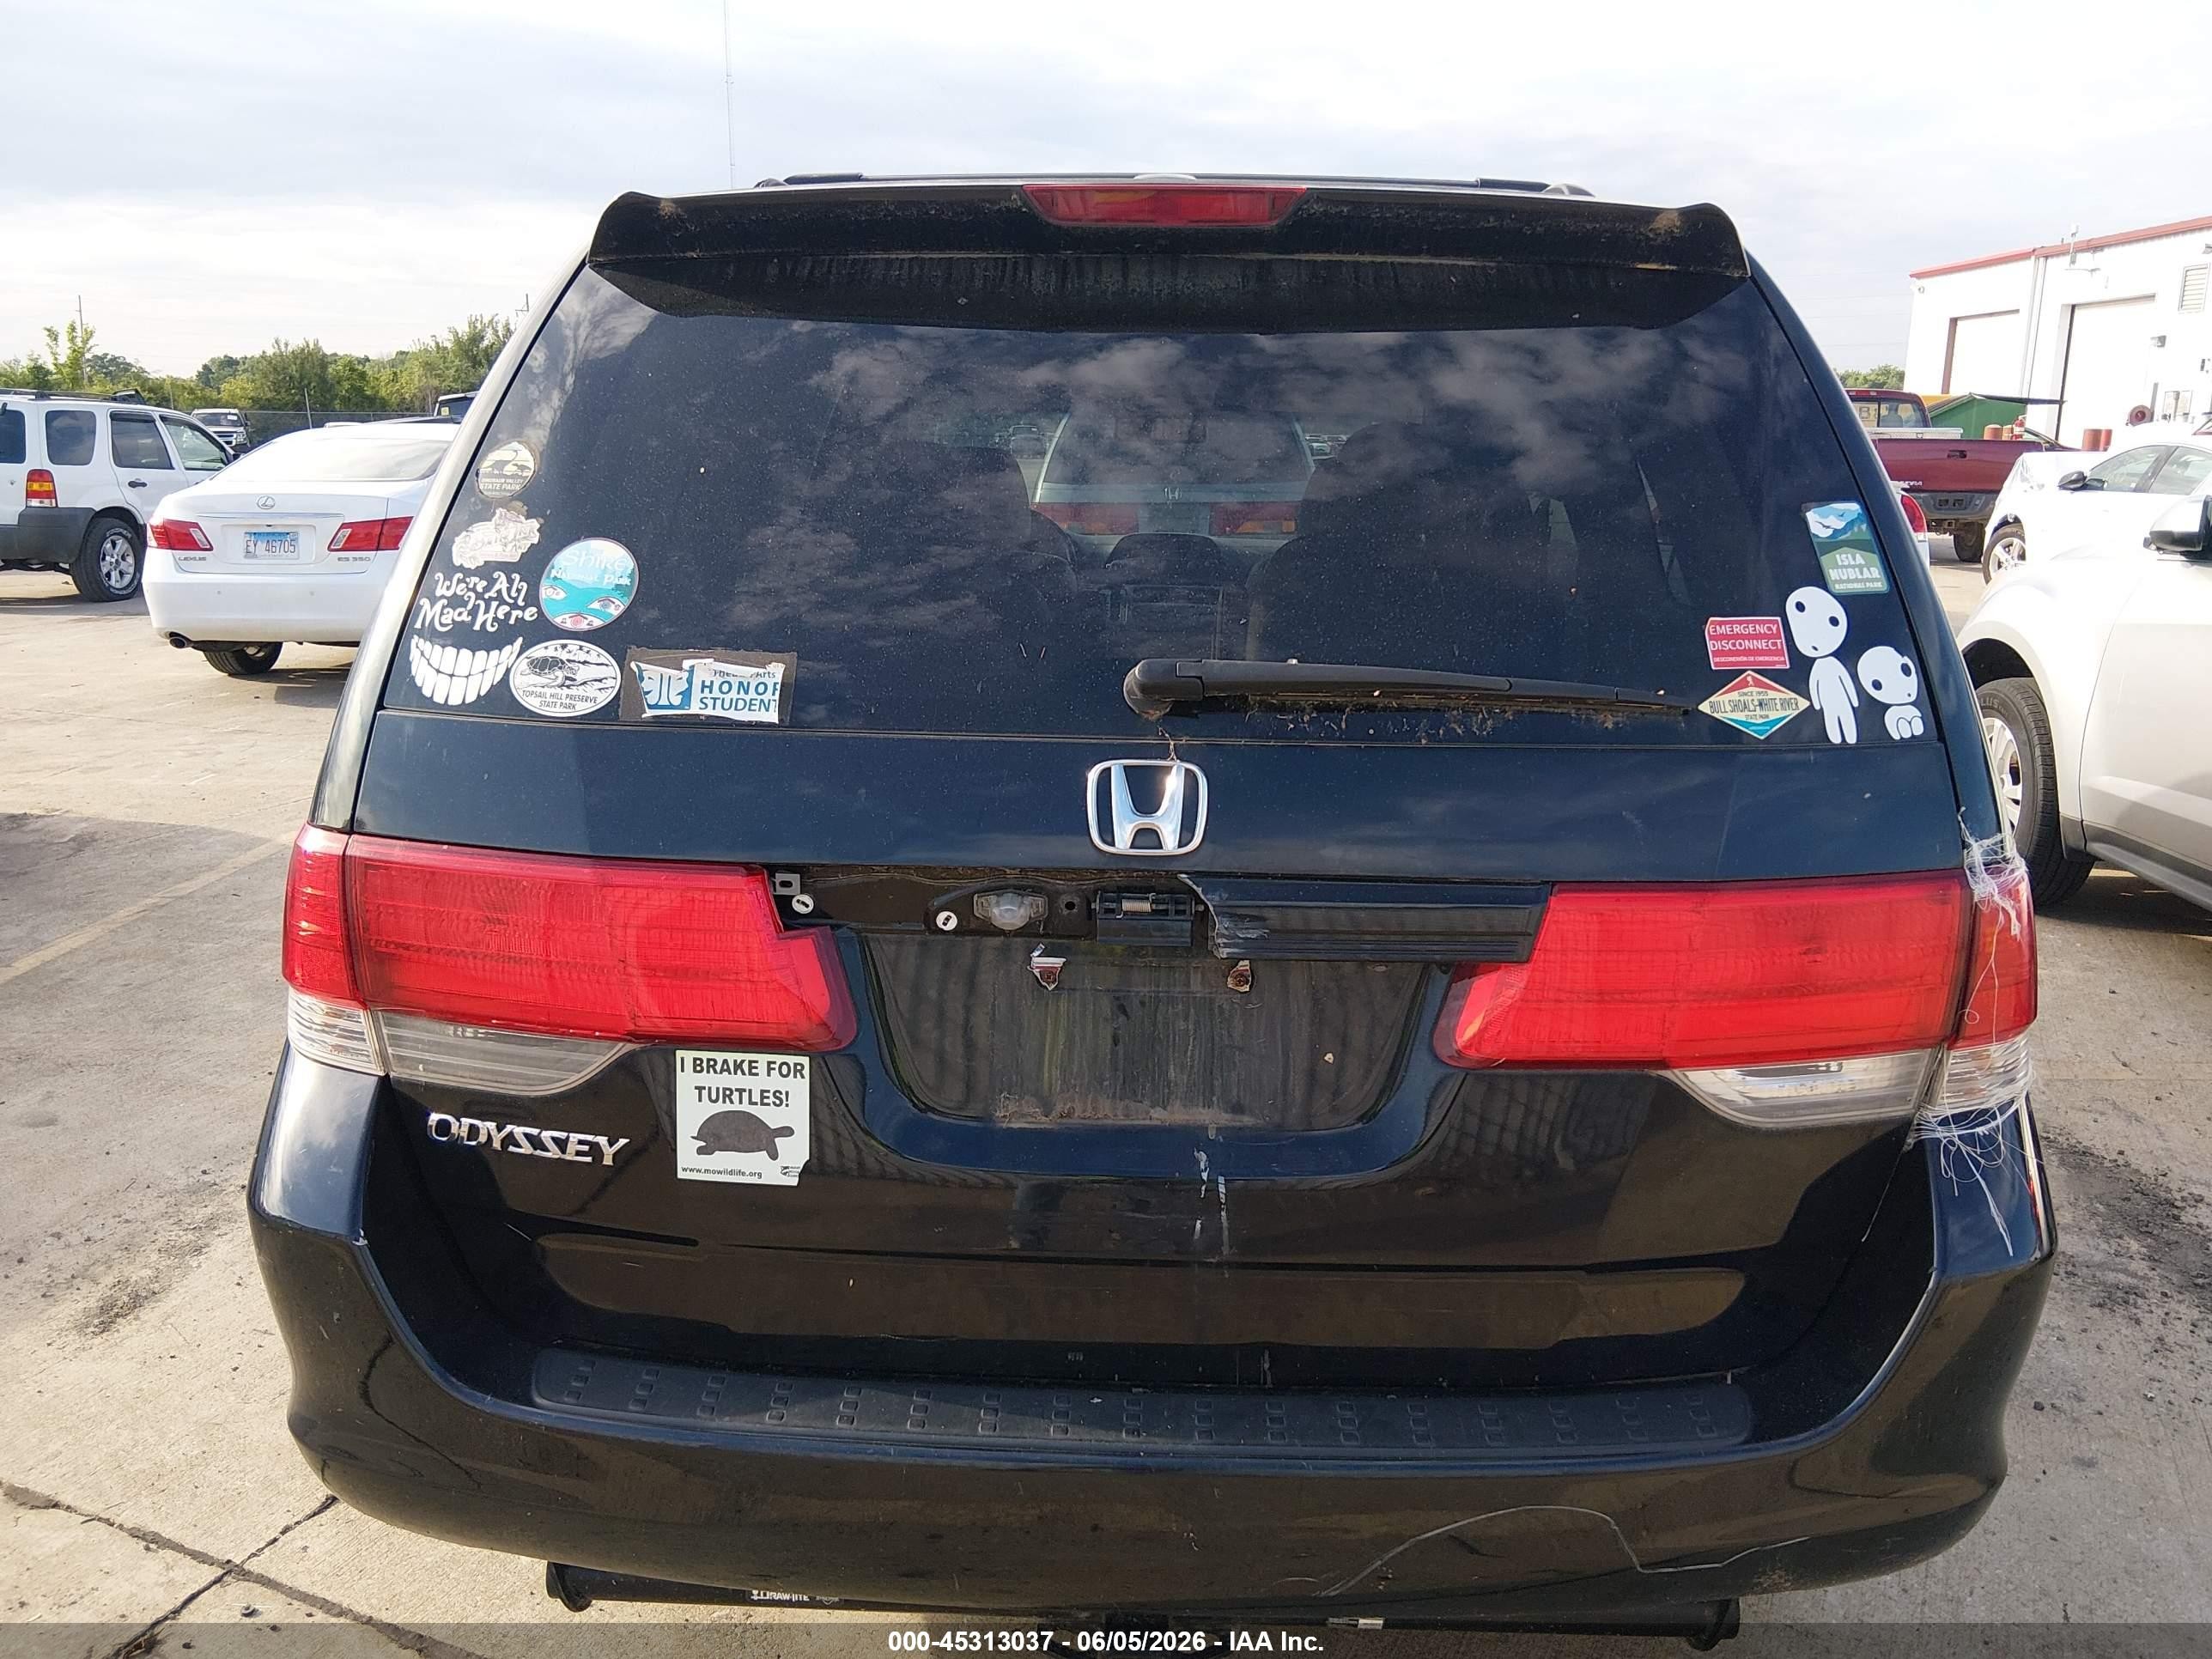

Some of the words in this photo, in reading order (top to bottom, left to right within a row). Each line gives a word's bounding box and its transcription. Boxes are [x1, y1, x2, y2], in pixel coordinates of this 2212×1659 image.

[246, 539, 258, 554] EY
[265, 539, 296, 554] 46705
[1835, 553, 1865, 565] ISLA
[1828, 567, 1881, 580] NUBLAR
[434, 572, 488, 597] We're
[414, 592, 476, 632] Mad
[472, 599, 538, 632] Here
[1710, 623, 1778, 635] EMERGENCY
[1710, 639, 1782, 651] DISCONNECT
[522, 690, 548, 699] TOPSAIL
[550, 691, 563, 701] HILL
[565, 693, 599, 704] PRESERVE
[538, 700, 558, 708] STATE
[559, 702, 577, 710] PARK
[1709, 700, 1728, 714] BULL
[680, 1056, 685, 1073] I
[692, 1057, 759, 1077] BRAKE
[766, 1060, 805, 1079] FOR
[694, 1085, 790, 1108] TURTLES!
[428, 1112, 630, 1166] ODYSSEY
[681, 1166, 763, 1179] www.mowildlife.org
